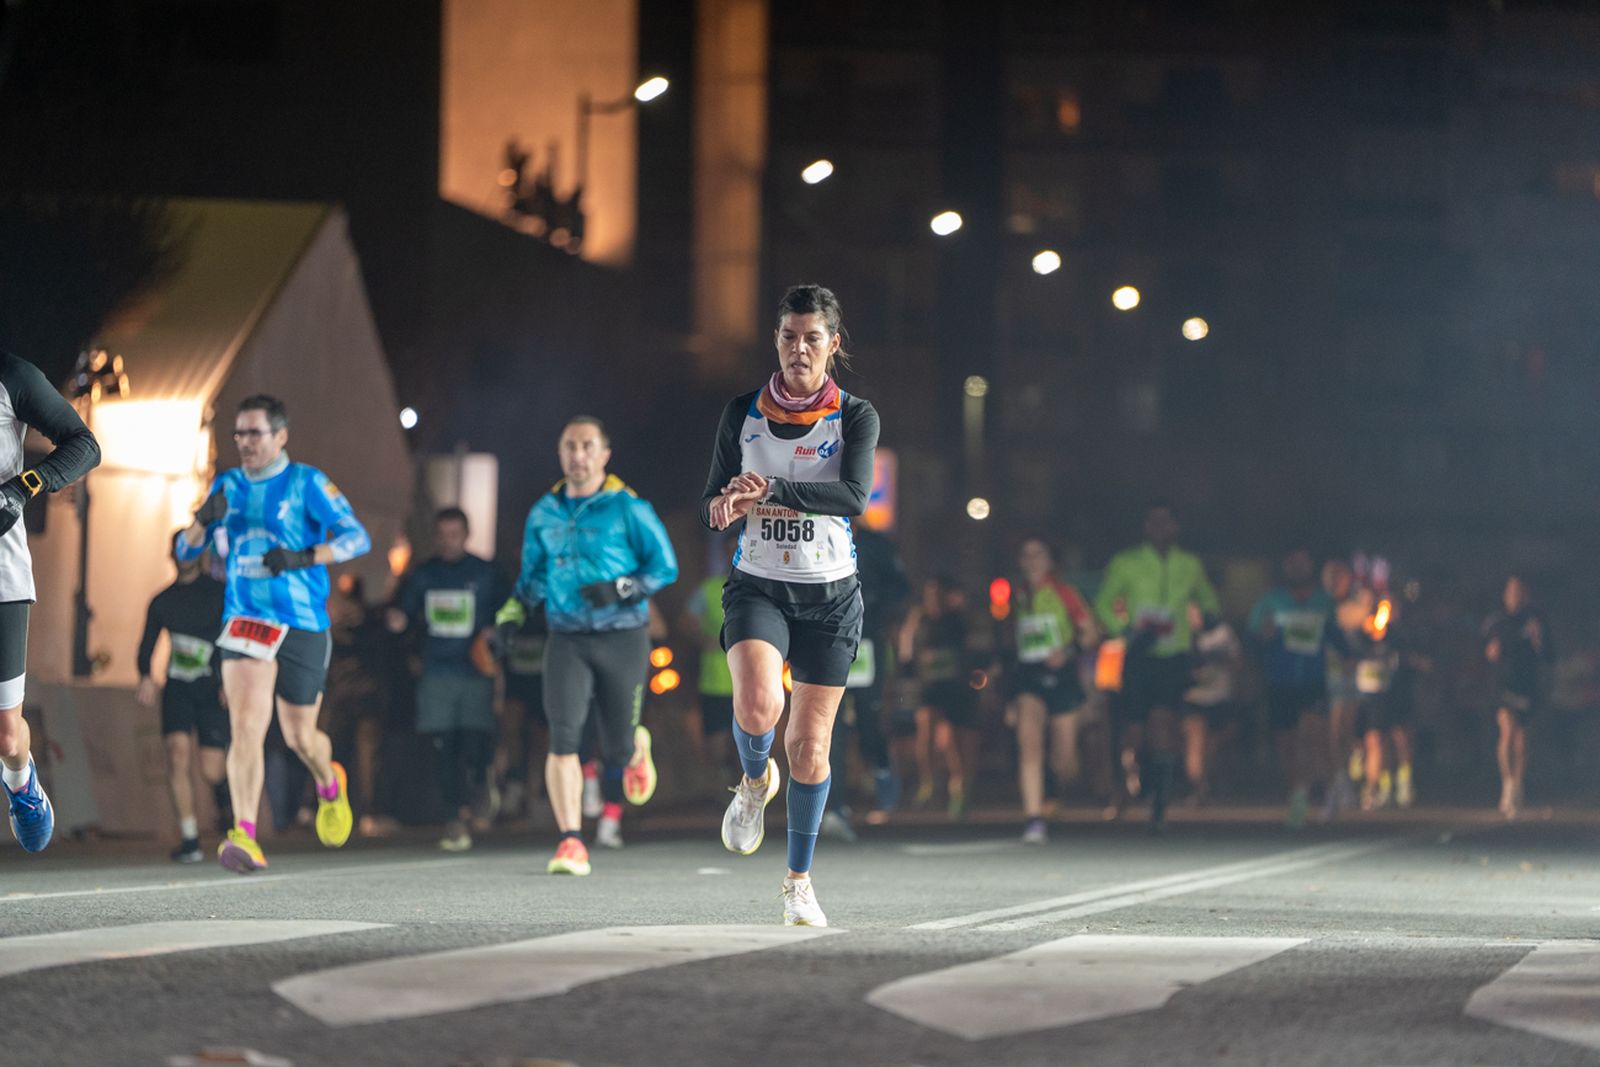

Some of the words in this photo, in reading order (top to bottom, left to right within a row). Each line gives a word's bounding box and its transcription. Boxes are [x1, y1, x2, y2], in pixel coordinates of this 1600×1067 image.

[795, 446, 817, 456] Run
[756, 507, 771, 517] SAN
[761, 518, 815, 543] 5058
